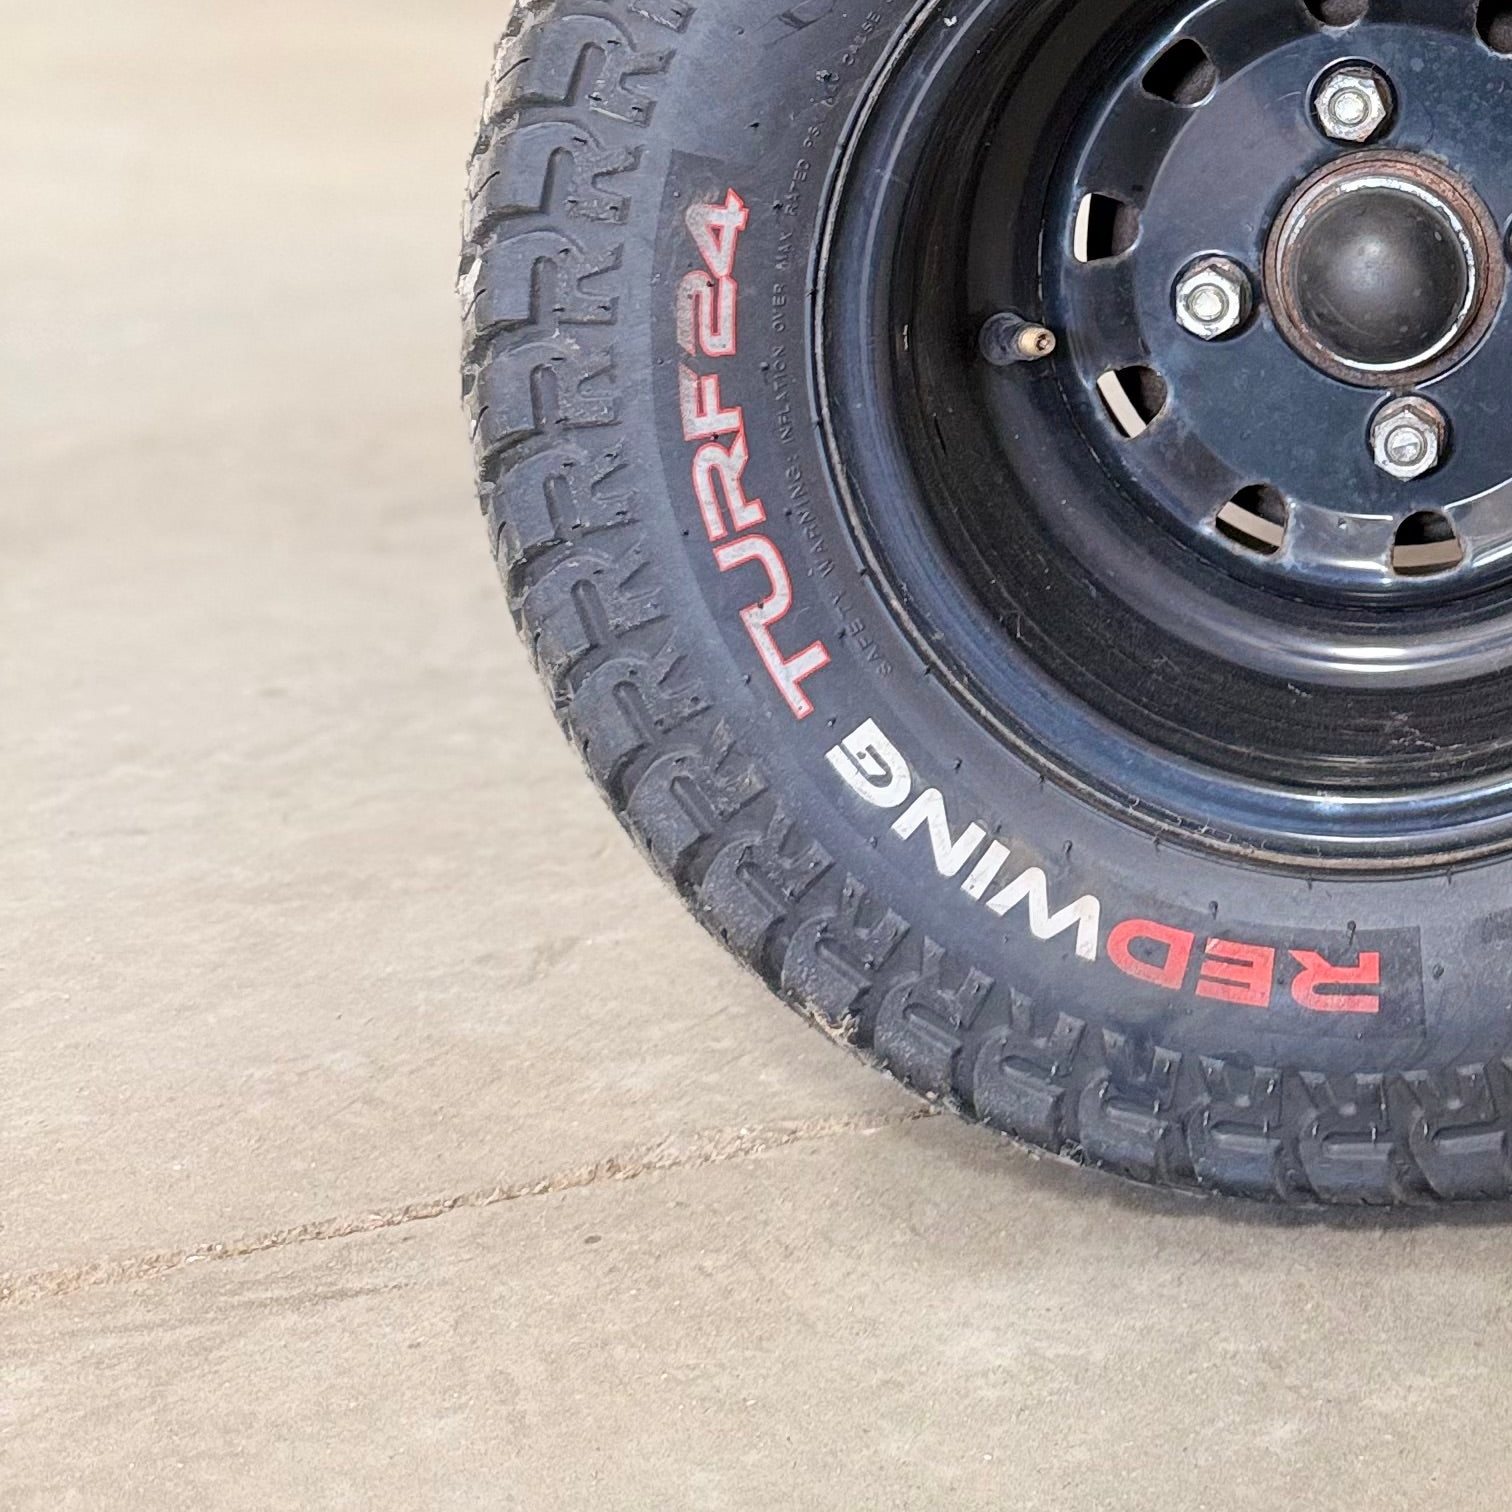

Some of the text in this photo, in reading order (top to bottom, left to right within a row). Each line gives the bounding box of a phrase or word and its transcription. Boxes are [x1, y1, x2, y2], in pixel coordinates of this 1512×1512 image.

[781, 155, 813, 218] RATED
[770, 281, 788, 332] OVER
[769, 345, 796, 445] INFLATION
[827, 586, 897, 683] SAFETY
[824, 717, 1380, 1013] REDWING
